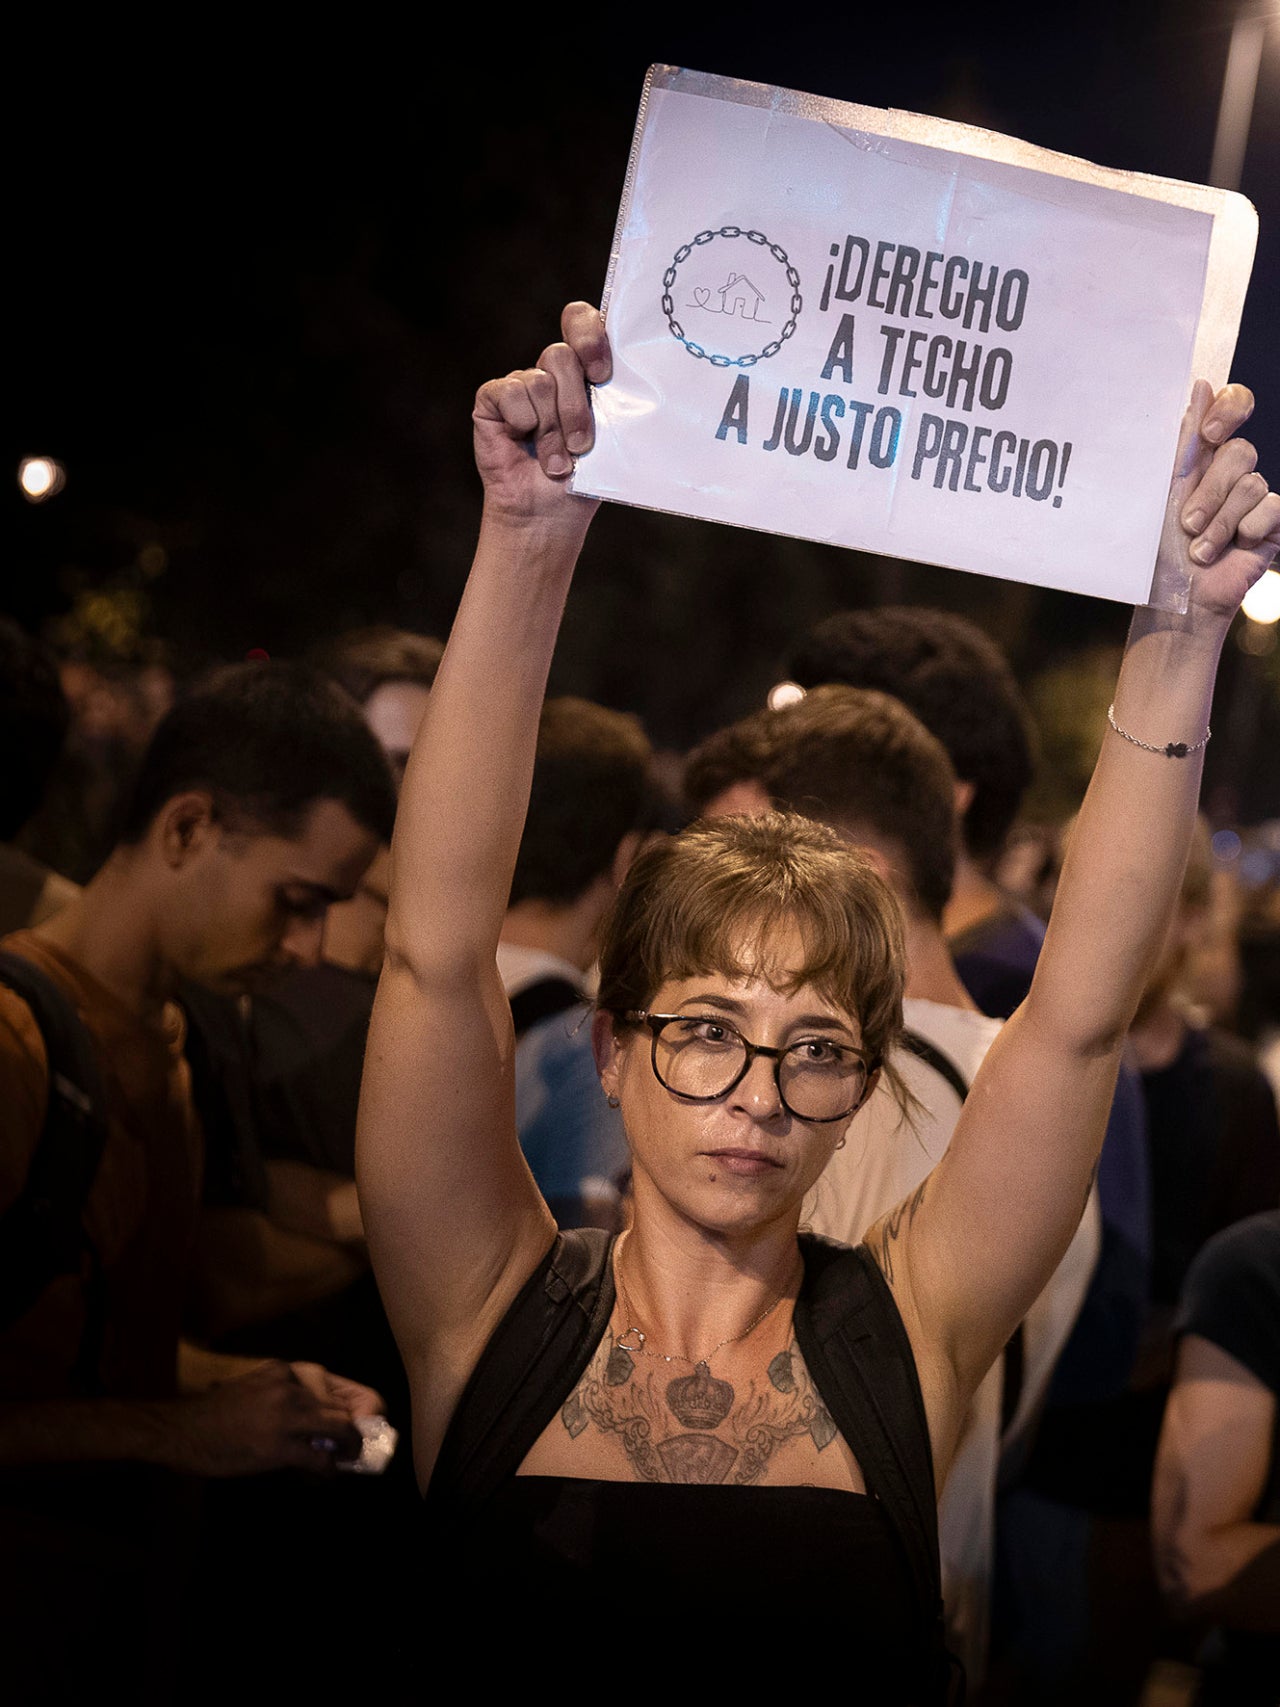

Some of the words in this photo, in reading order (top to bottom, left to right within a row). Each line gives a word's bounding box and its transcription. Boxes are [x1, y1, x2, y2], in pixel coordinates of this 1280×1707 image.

[818, 234, 1030, 333] ¡DERECHO
[820, 313, 855, 385] A
[877, 324, 1014, 412] TECHO
[714, 373, 750, 445] A
[762, 386, 903, 471] JUSTO
[910, 412, 1074, 510] PRECIO!
